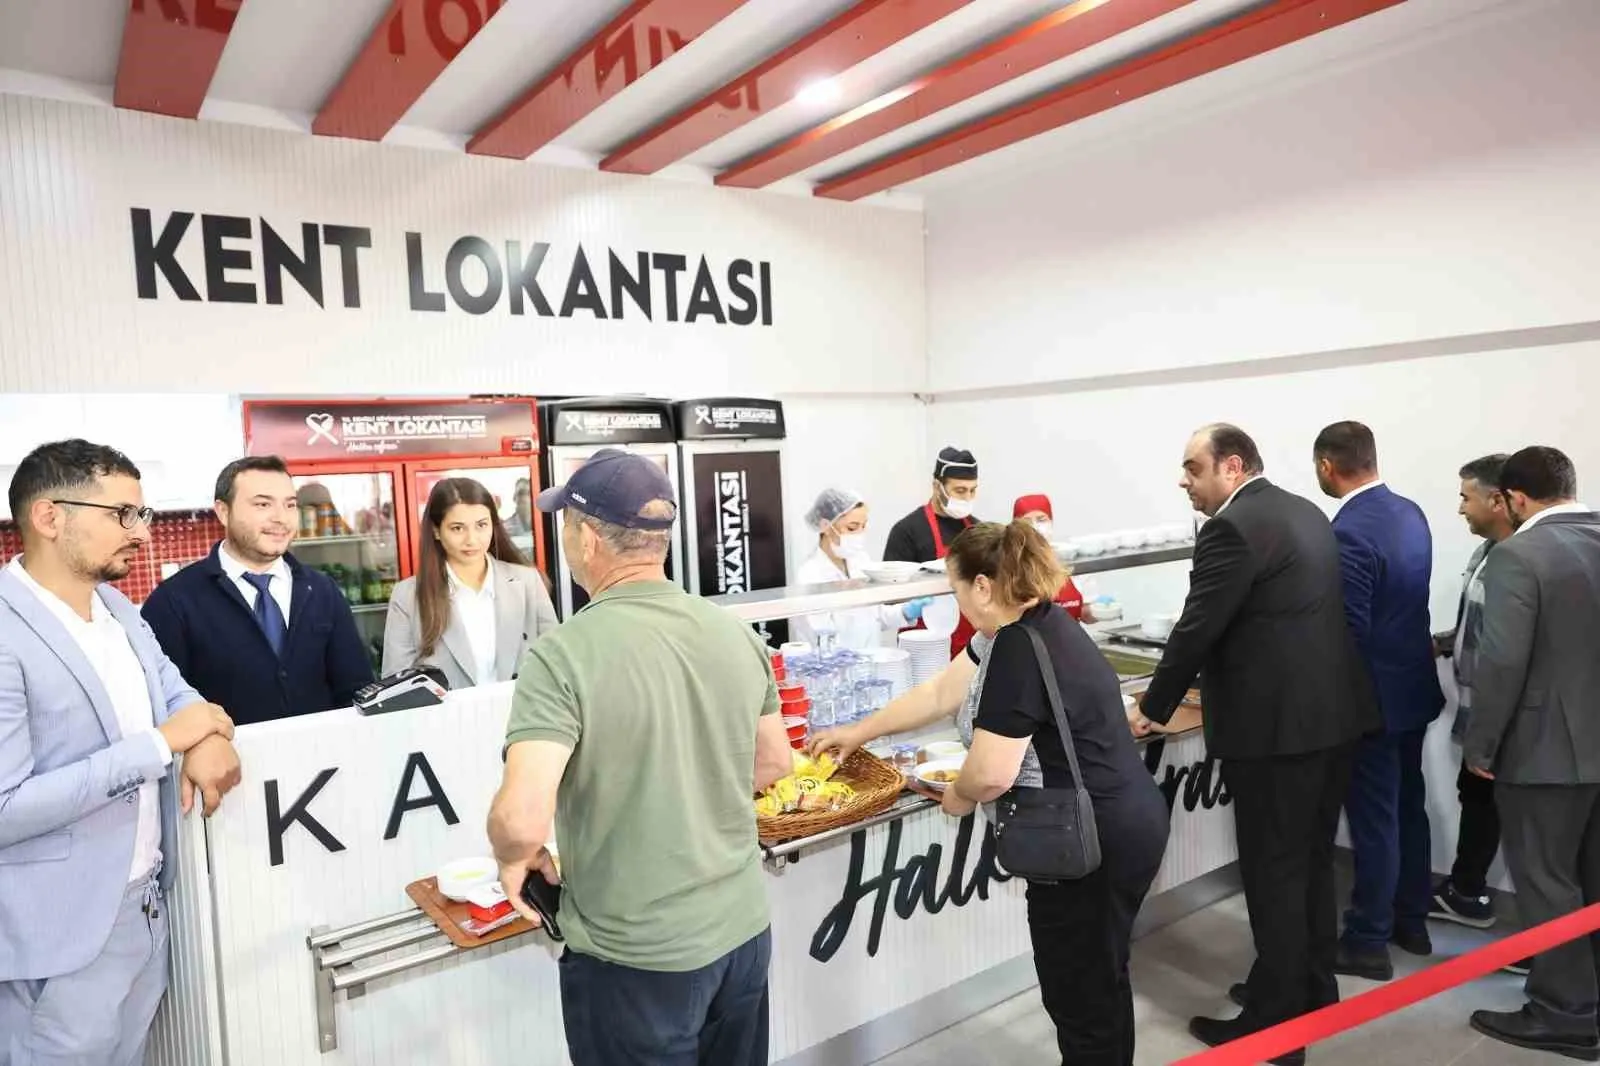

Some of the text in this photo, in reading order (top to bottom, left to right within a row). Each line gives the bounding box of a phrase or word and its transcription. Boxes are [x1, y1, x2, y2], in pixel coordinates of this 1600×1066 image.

[131, 208, 773, 326] KENT LOKANTASI
[342, 420, 389, 436] KENT
[394, 418, 486, 434] LOKANTASI
